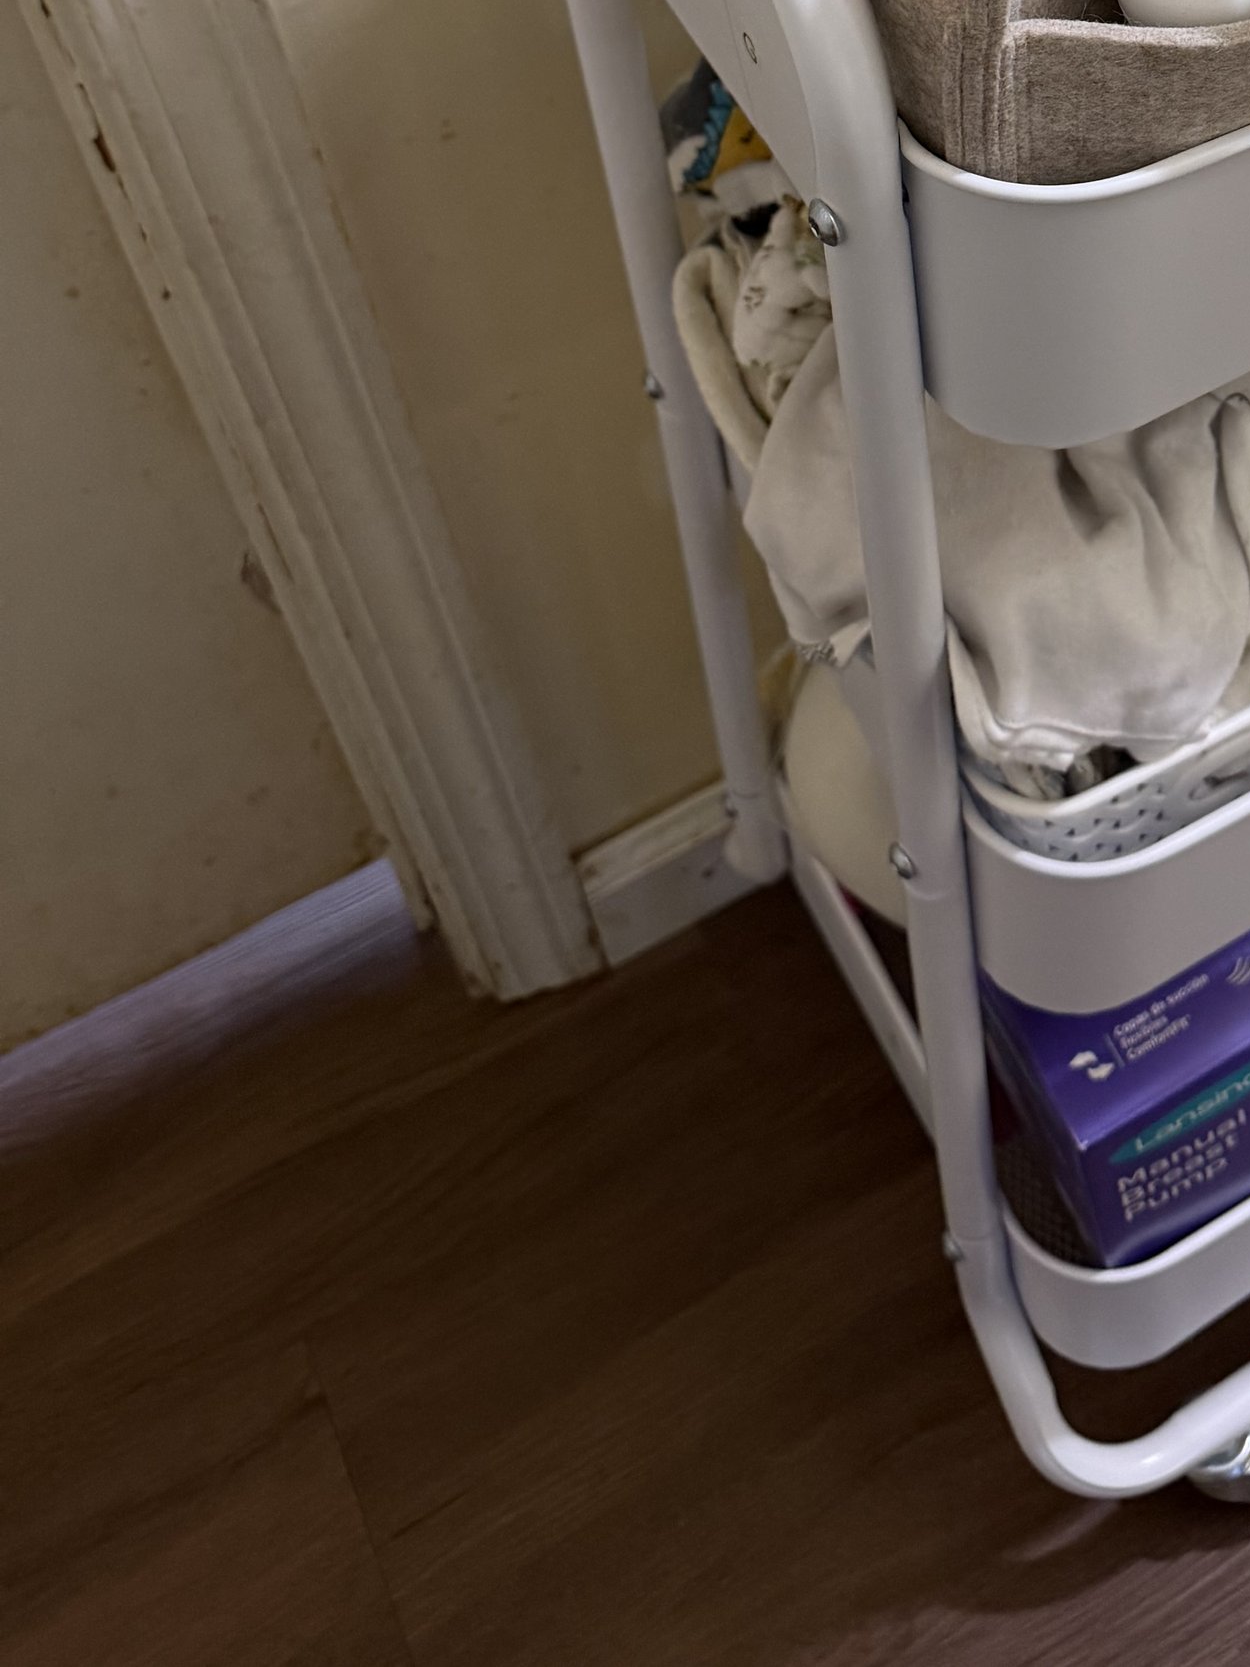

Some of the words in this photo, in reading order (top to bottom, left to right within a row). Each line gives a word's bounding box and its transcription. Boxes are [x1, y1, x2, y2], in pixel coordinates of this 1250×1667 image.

[1117, 1107, 1248, 1194] Manual
[1120, 1133, 1240, 1209] Breast
[1123, 1155, 1230, 1224] Pump
